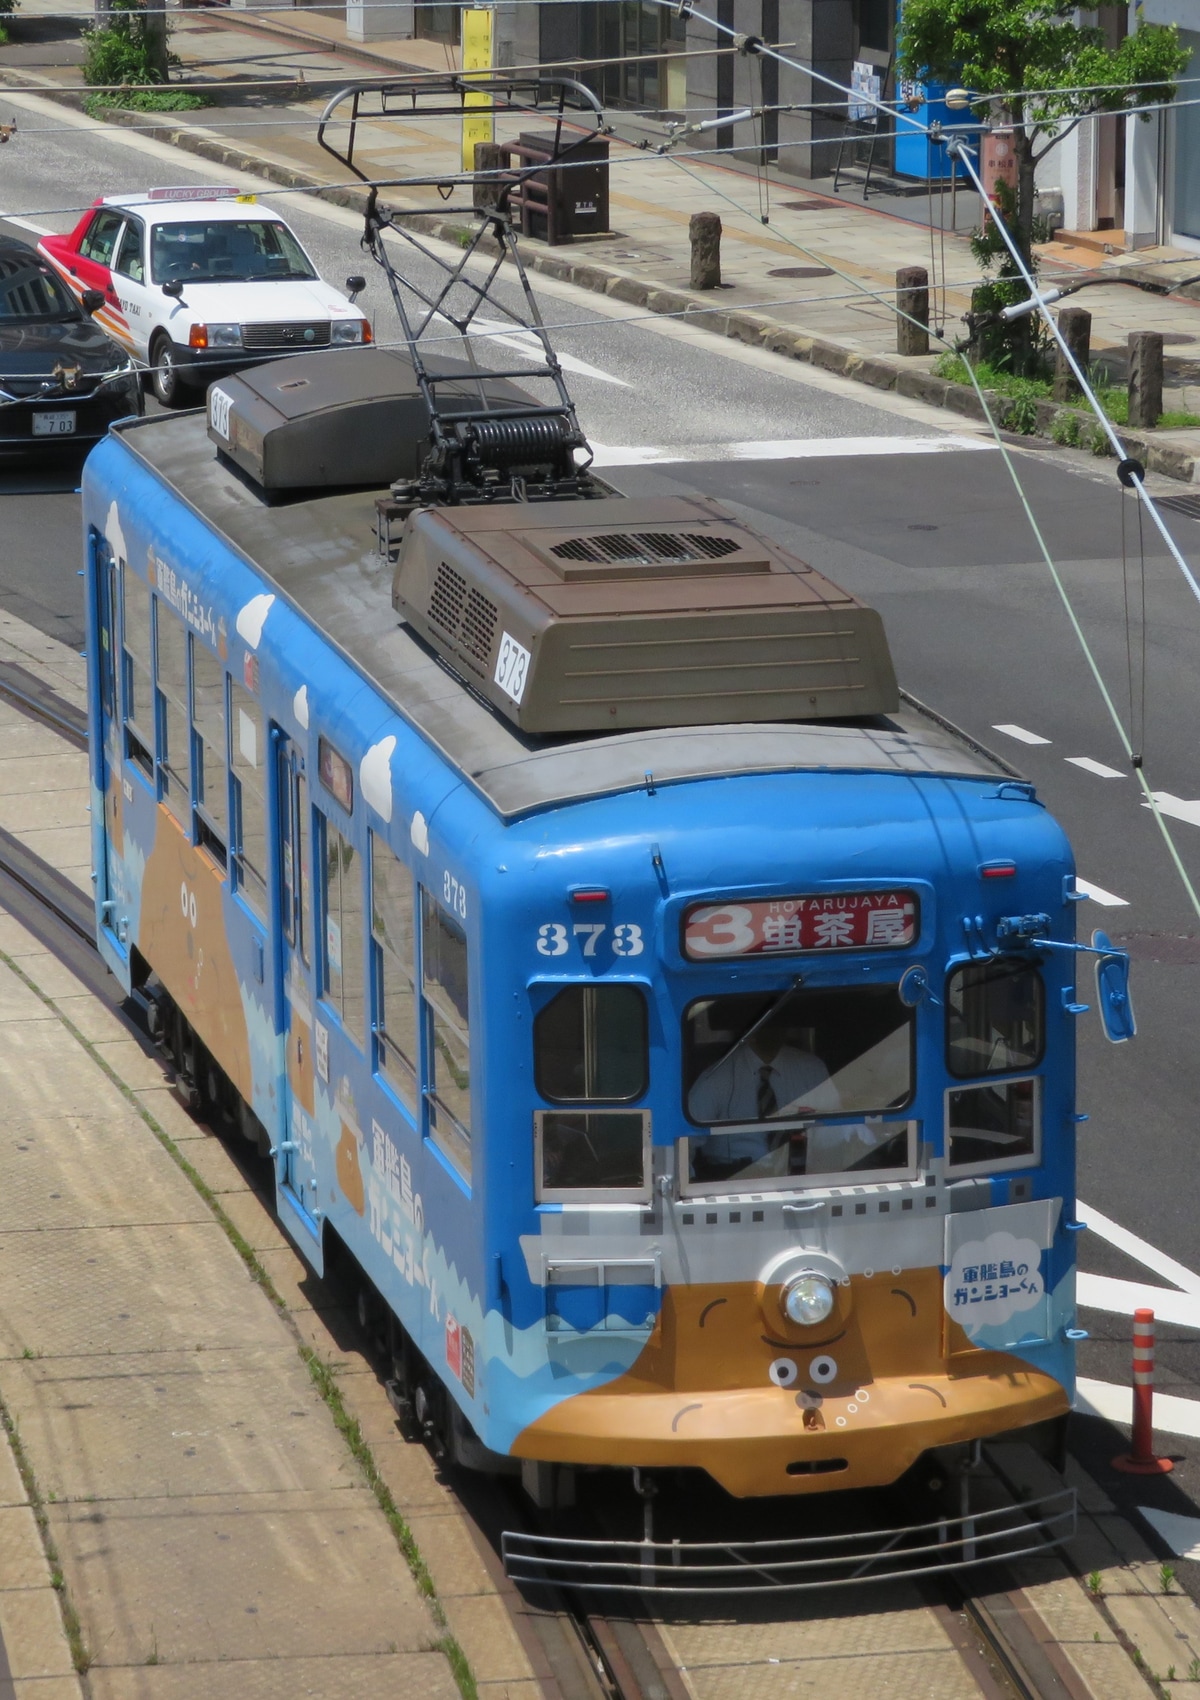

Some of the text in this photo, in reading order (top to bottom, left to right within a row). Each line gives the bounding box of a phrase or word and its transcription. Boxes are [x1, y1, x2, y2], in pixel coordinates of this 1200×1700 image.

[164, 190, 195, 199] LUCKY
[196, 189, 229, 198] GROUP
[213, 392, 228, 435] 373
[499, 639, 526, 697] 373
[444, 870, 467, 919] 373
[769, 894, 899, 913] HOTARUJAYA
[536, 923, 644, 957] 373
[687, 904, 754, 955] 3
[371, 1117, 424, 1234] 軍艦島の
[369, 1175, 440, 1323] ガンショーくん
[954, 1278, 1038, 1306] ガンショーくん
[963, 1261, 1029, 1283] 軍艦島の
